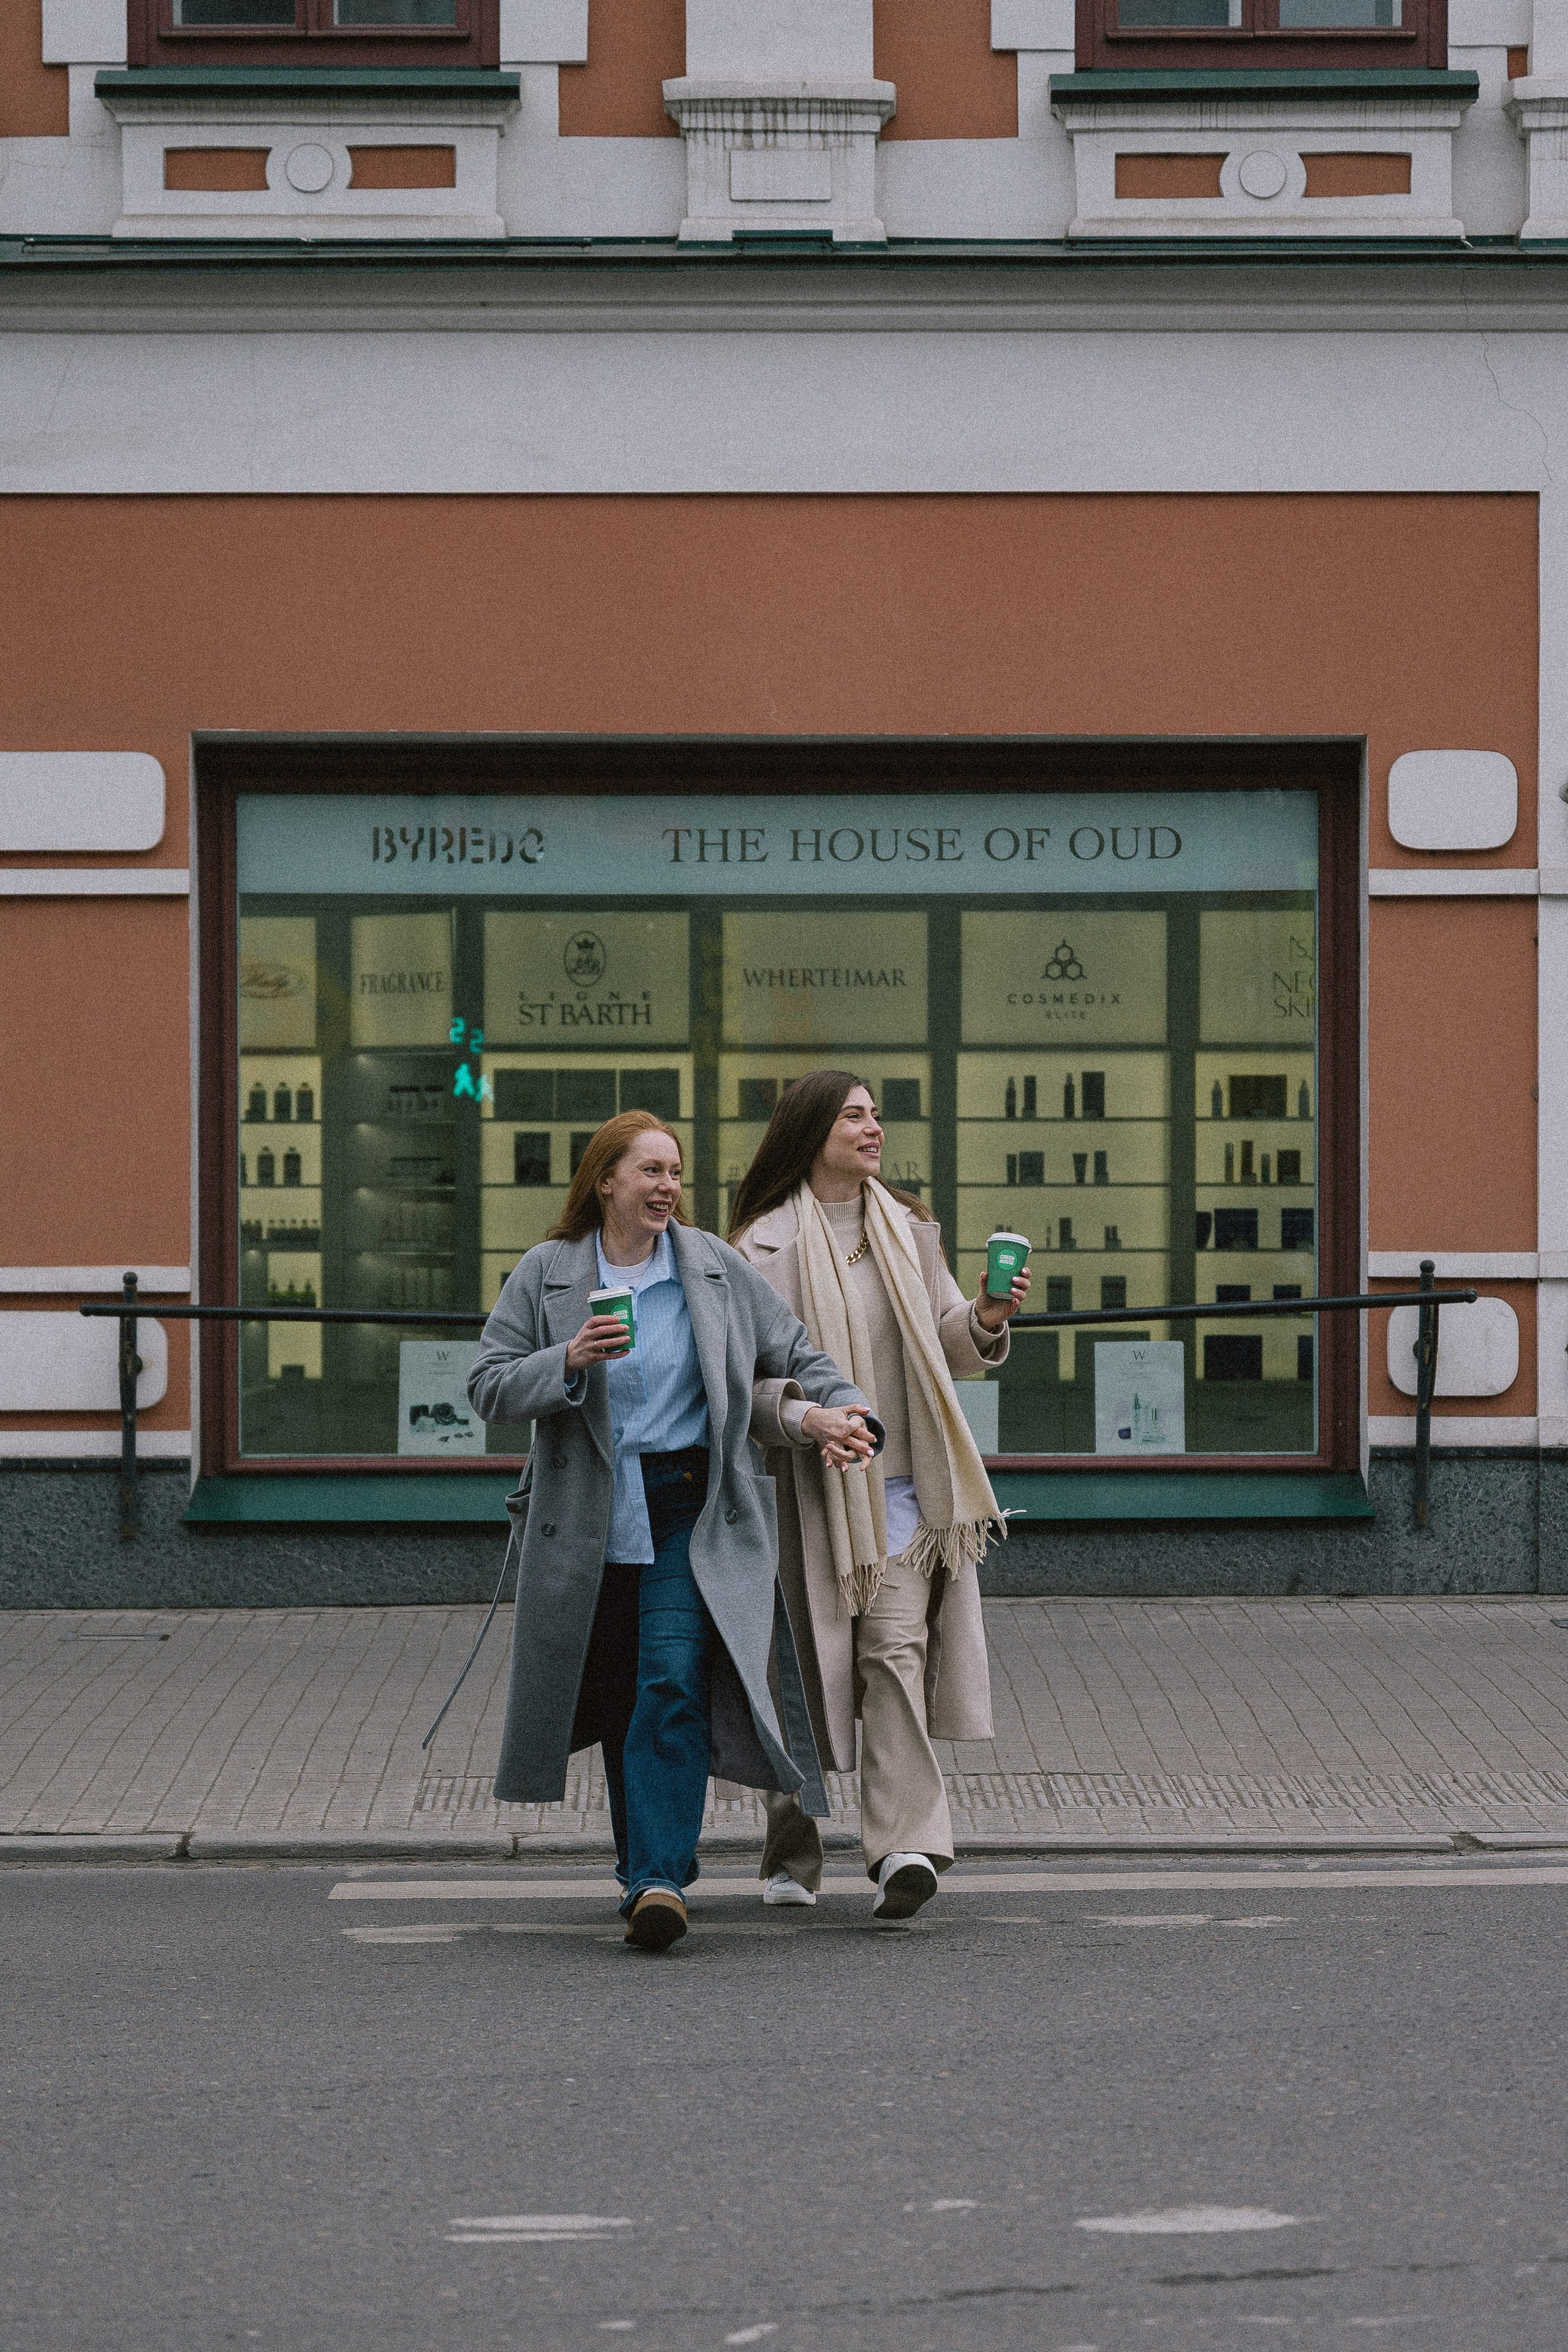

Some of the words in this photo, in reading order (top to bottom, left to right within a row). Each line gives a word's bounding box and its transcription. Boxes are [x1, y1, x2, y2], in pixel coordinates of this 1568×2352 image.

[372, 826, 544, 864] BYREDO
[662, 827, 769, 862] THE
[790, 827, 965, 861] HOUSE
[984, 827, 1050, 861] OF
[1069, 826, 1182, 860] OUD
[360, 971, 445, 995] FRAGRANCE
[743, 968, 907, 987] WHERTEIMAR
[1273, 971, 1315, 993] NE
[519, 990, 650, 1001] LIGNE
[1008, 993, 1120, 1004] COSMEDIX
[519, 1003, 553, 1025] ST
[560, 1003, 651, 1025] BARTH
[1045, 1011, 1086, 1020] ELITE
[436, 1350, 450, 1361] W
[1133, 1350, 1146, 1360] W
